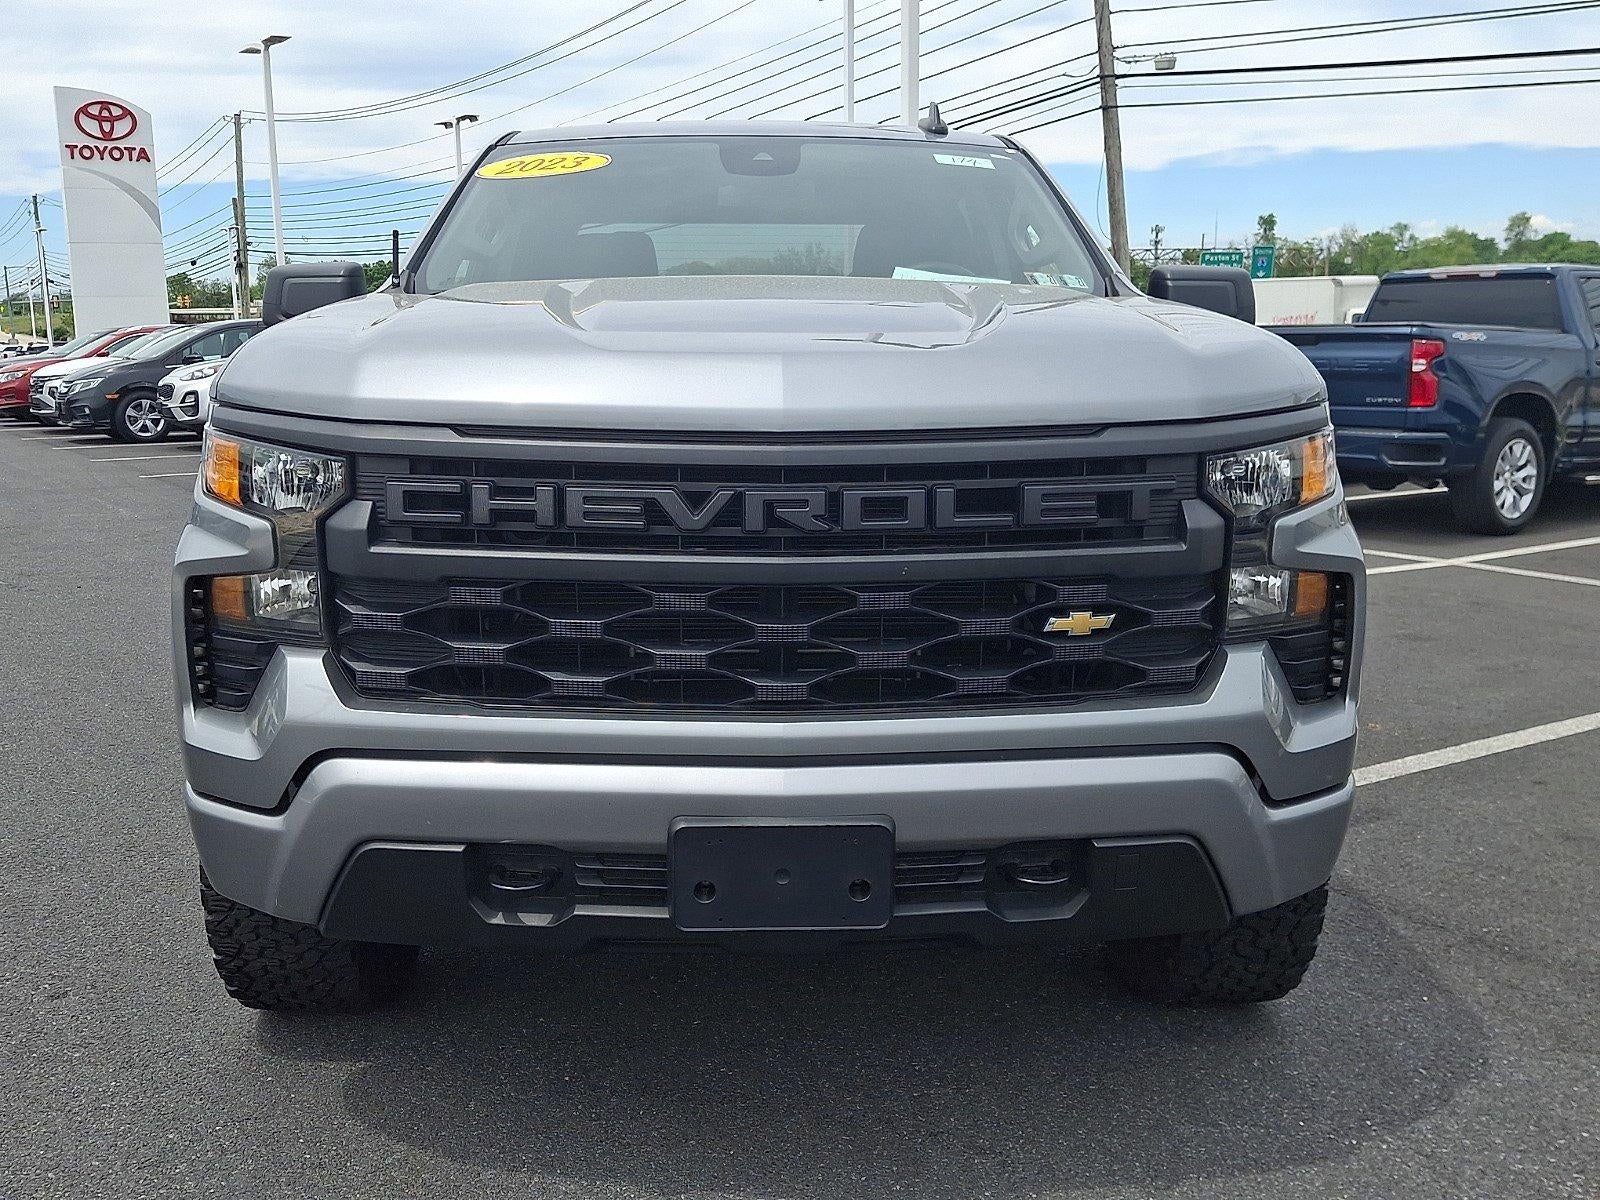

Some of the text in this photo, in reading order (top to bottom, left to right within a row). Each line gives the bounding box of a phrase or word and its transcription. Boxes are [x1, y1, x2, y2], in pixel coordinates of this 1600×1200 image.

[65, 144, 151, 163] TOYOTA
[494, 156, 590, 176] 2023
[1204, 254, 1240, 262] Paxton St
[385, 476, 1177, 534] CHEVROLET
